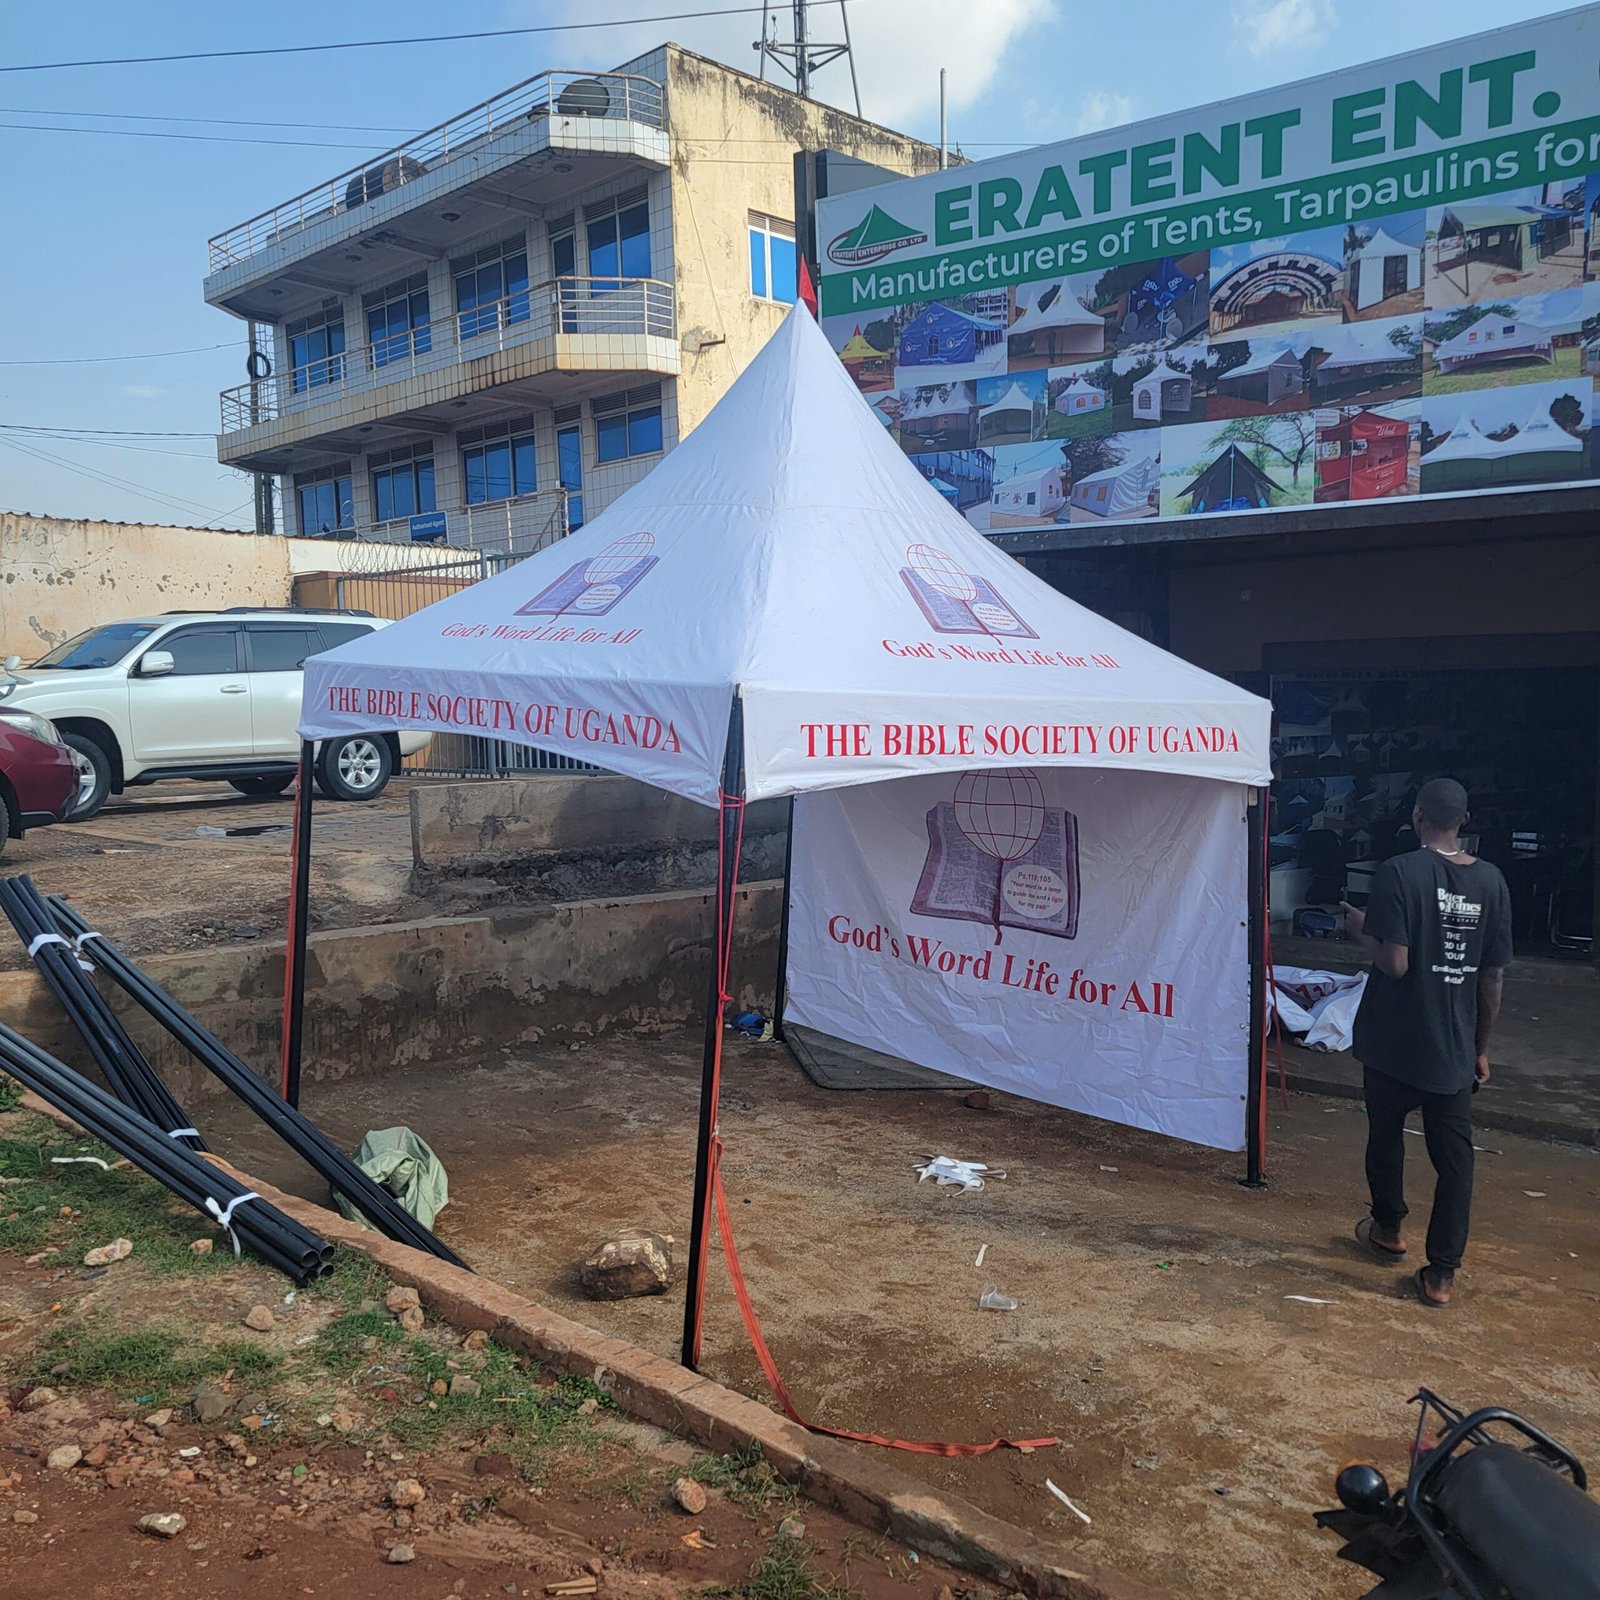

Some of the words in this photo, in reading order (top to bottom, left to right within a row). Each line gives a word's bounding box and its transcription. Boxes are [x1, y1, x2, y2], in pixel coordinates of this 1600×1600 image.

[935, 108, 1301, 246] ERATENT
[1332, 50, 1561, 164] ENT.
[851, 238, 1088, 304] Manufacturers
[1100, 221, 1135, 256] of
[1145, 206, 1262, 249] Tents,
[1275, 150, 1520, 224] Tarpaulins
[1534, 132, 1600, 173] for
[832, 250, 856, 259] ERATENT
[857, 242, 897, 257] ENTERPRISE
[910, 237, 923, 245] LTD
[441, 622, 488, 640] God's
[492, 625, 545, 642] Word
[538, 626, 580, 643] Life
[574, 627, 607, 644] for
[602, 629, 642, 645] All
[882, 638, 953, 660] God's
[947, 643, 1015, 664] Word
[1010, 648, 1059, 667] Life
[1055, 650, 1089, 668] for
[1091, 653, 1120, 669] All
[327, 685, 362, 714] THE
[366, 687, 422, 719] BIBLE
[426, 692, 520, 731] SOCIETY
[524, 703, 561, 736] OF
[564, 706, 682, 754] UGANDA
[800, 723, 873, 759] THE
[881, 724, 975, 757] BIBLE
[983, 725, 1103, 756] SOCIETY
[1108, 725, 1141, 754] OF
[1146, 726, 1240, 754] UGANDA
[1446, 931, 1461, 940] THE
[828, 914, 900, 959] God's
[905, 934, 991, 981] Word
[1000, 953, 1060, 995] Life
[1067, 967, 1116, 1007] for
[1119, 980, 1175, 1018] All
